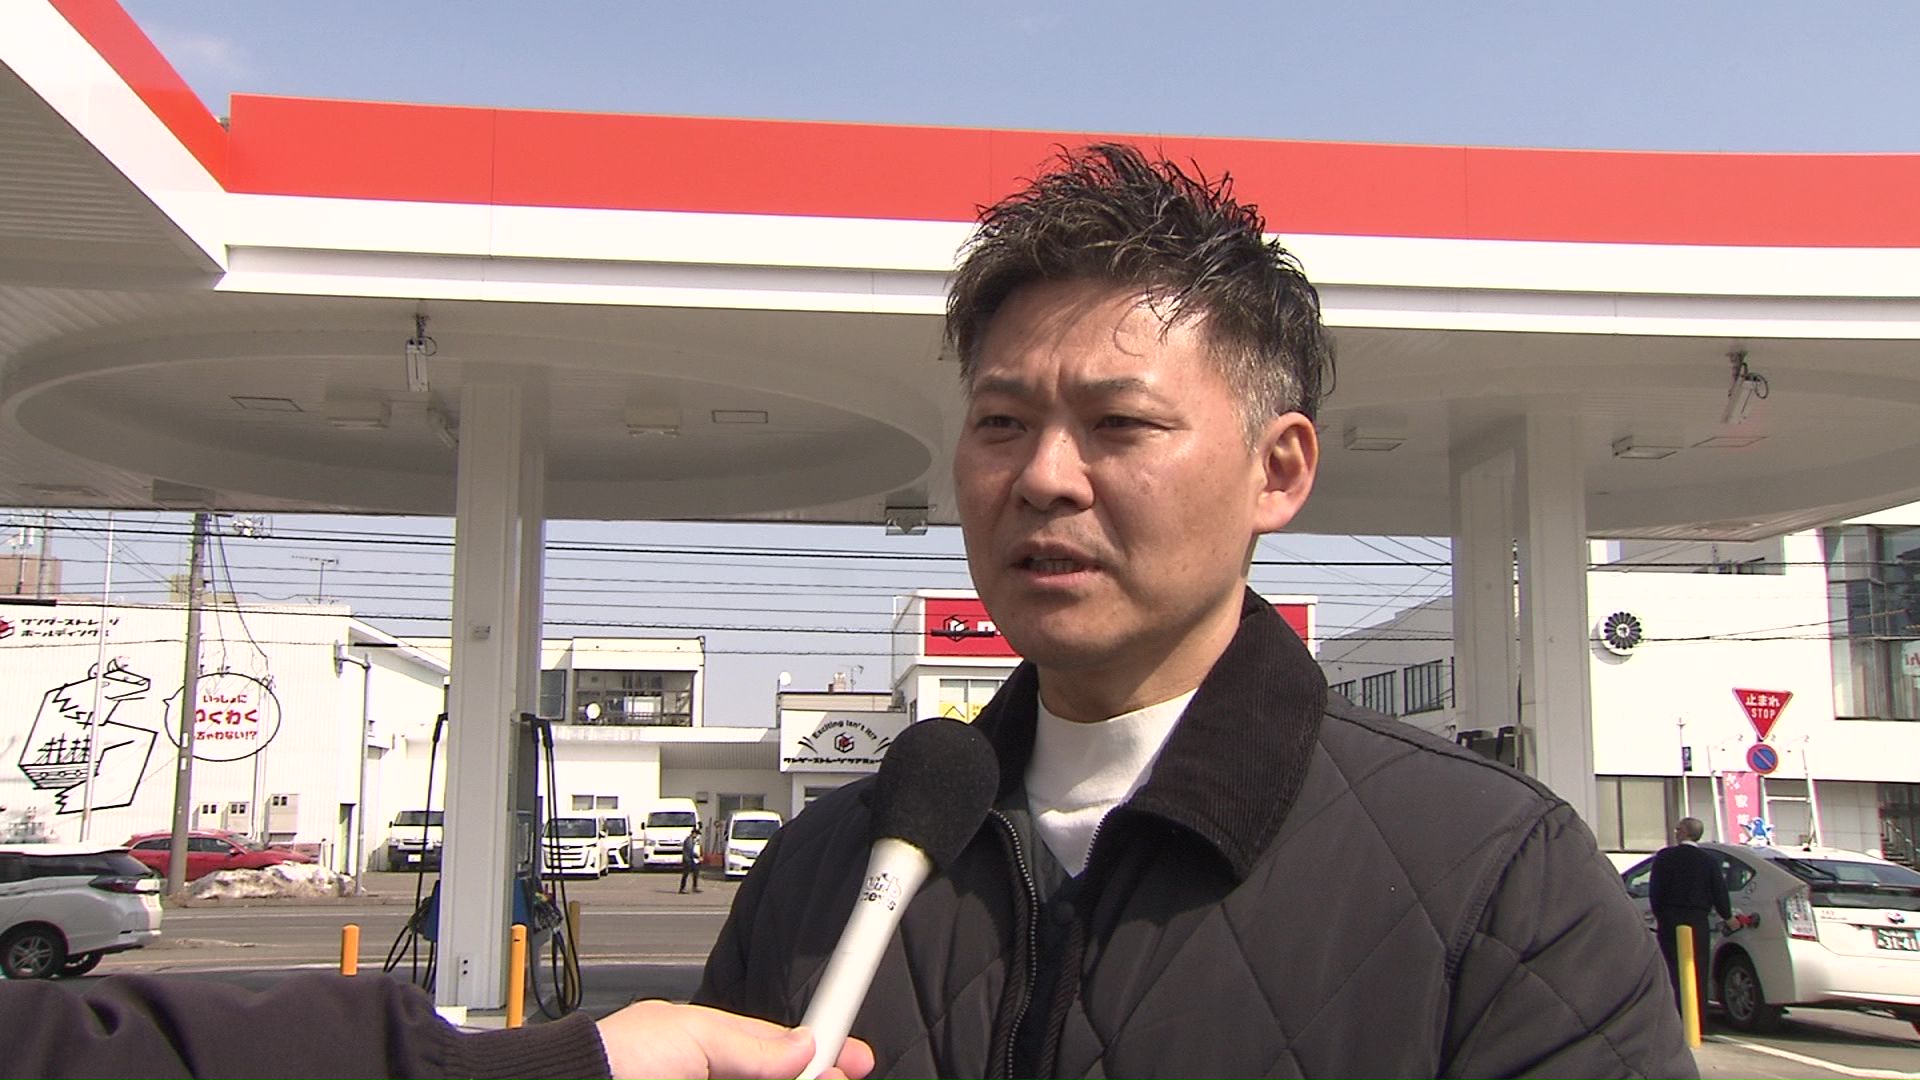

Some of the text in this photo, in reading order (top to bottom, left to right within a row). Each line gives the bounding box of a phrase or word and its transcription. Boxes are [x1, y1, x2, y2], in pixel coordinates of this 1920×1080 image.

[21, 617, 120, 626] ワンダーストレジ
[203, 694, 248, 704] いっしょに
[1745, 693, 1781, 707] 止まれ
[1751, 707, 1776, 719] STOP
[194, 730, 258, 741] ちゃわない!?
[811, 720, 844, 740] Exciting
